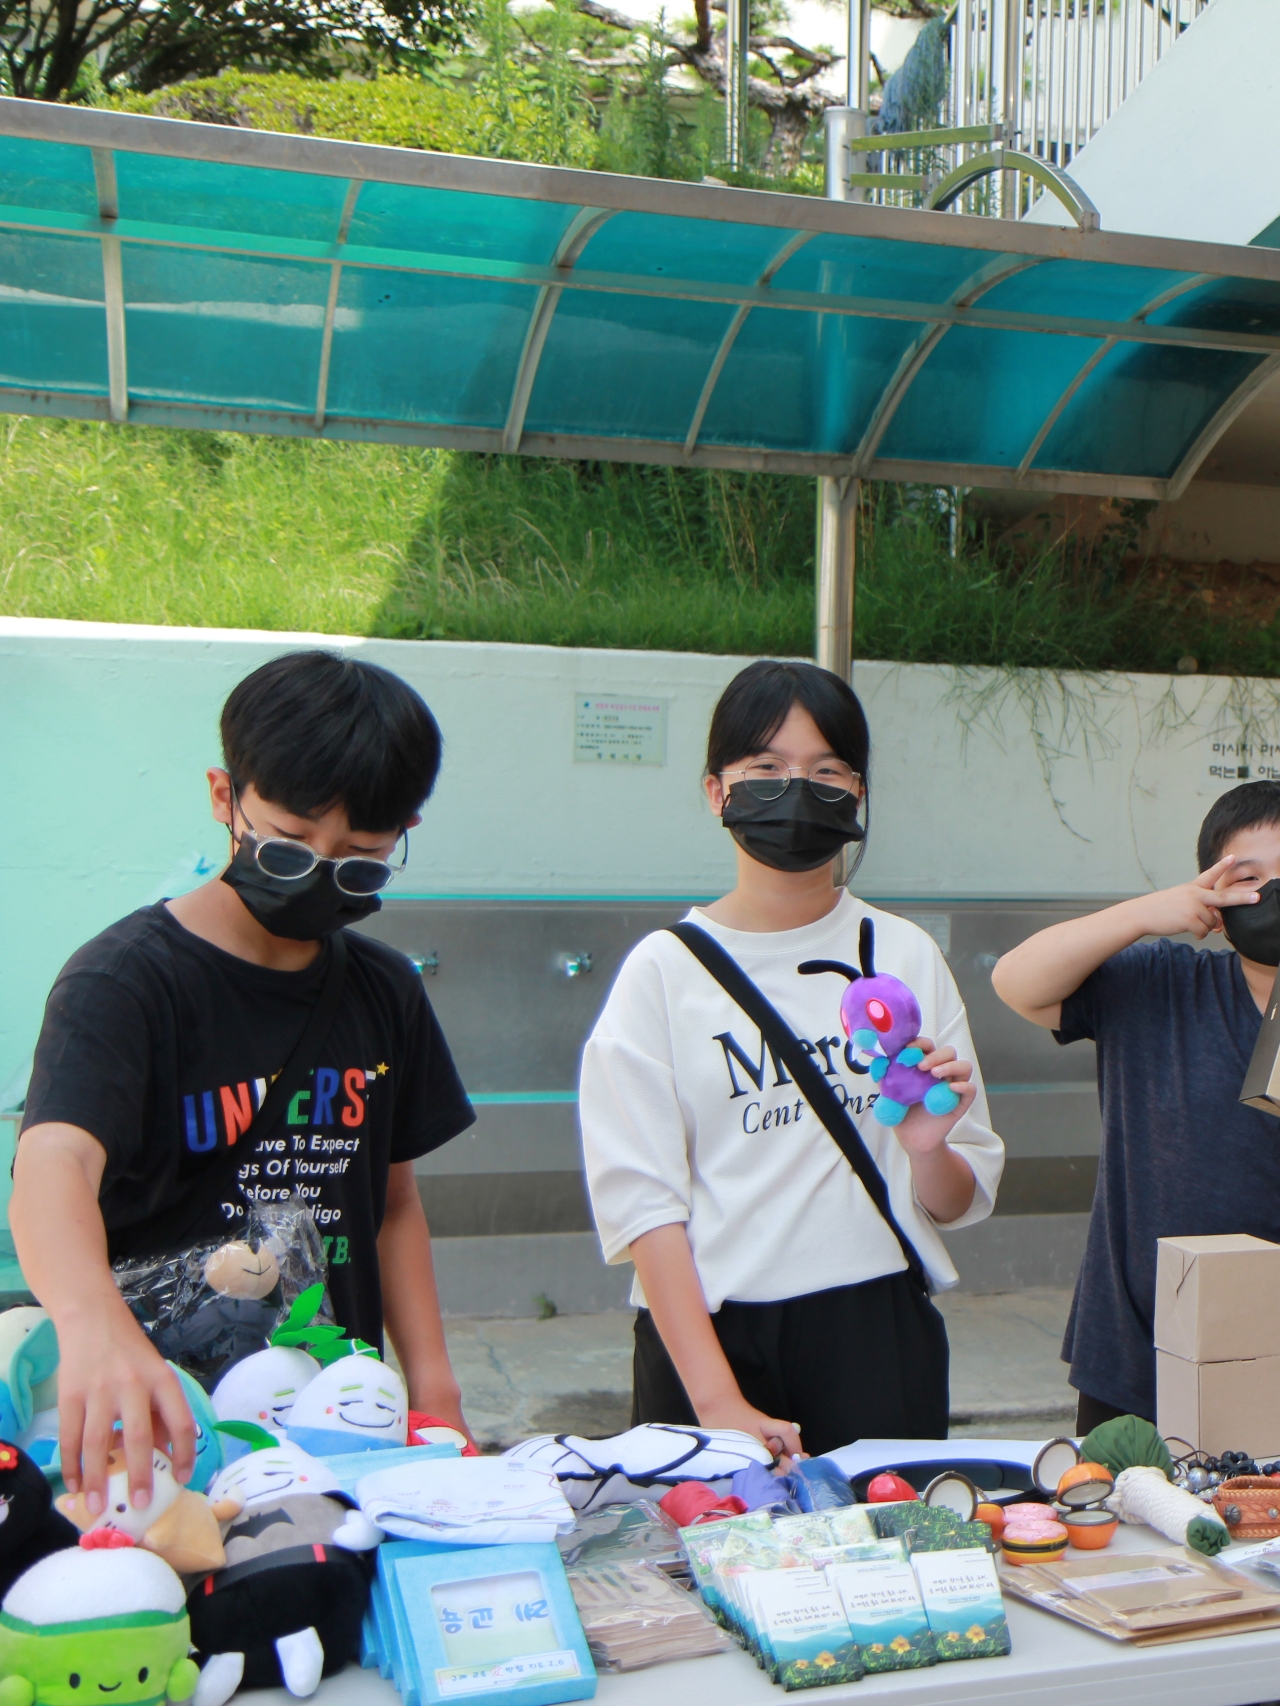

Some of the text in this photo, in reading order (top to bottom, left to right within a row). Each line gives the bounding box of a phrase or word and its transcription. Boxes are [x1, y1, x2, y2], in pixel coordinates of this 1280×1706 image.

[1209, 765, 1249, 779] 먹는
[255, 1134, 360, 1155] ave To Expect
[266, 1159, 291, 1176] Of
[294, 1158, 351, 1175] Yourself
[295, 1183, 322, 1199] You
